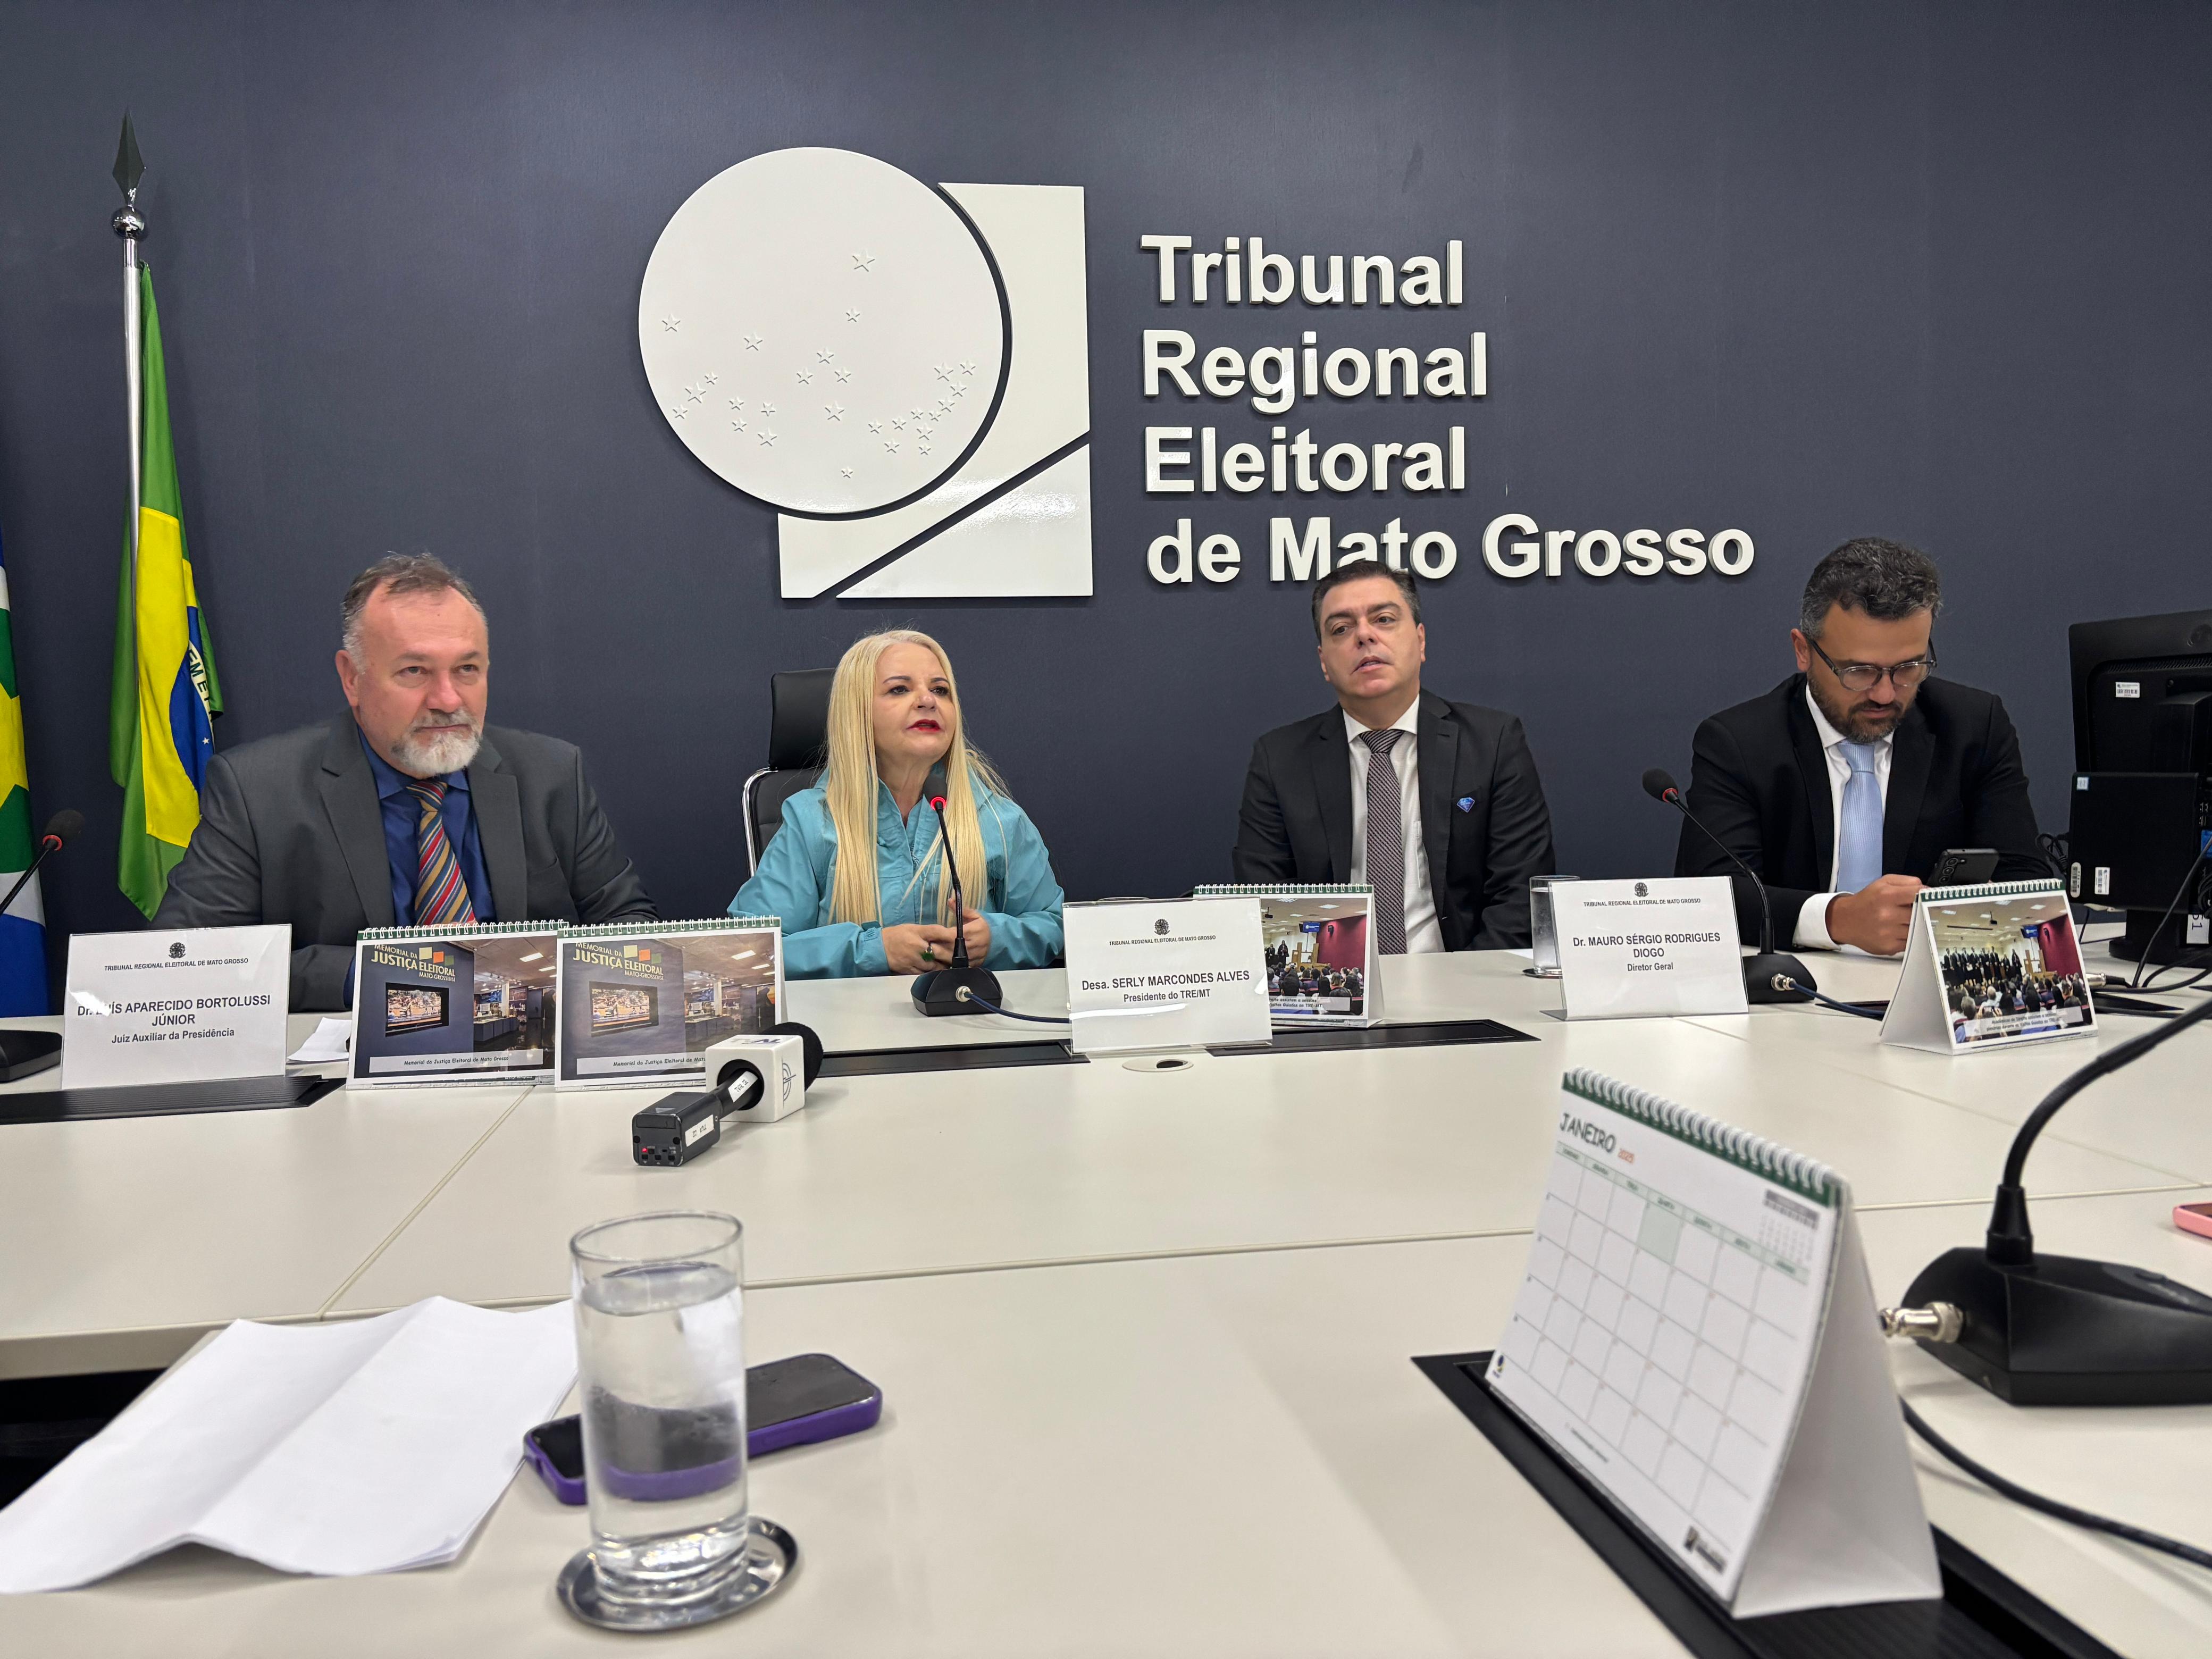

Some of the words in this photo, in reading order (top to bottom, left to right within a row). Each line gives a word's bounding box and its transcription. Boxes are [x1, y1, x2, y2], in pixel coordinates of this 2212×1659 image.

[1141, 234, 1463, 306] Tribunal
[1142, 329, 1487, 415] Regional
[1144, 426, 1465, 493] Eleitoral
[1146, 518, 1242, 584] de
[1270, 517, 1458, 582] Mato
[1482, 513, 1755, 579] Grosso
[575, 942, 613, 955] MEMORIAL
[1573, 937, 1586, 946] Dr.
[1588, 936, 1623, 946] MAURO
[1626, 933, 1662, 945] SÉRGIO
[1665, 932, 1721, 943] RODRIGUES
[374, 944, 409, 957] MEMORIAL
[1633, 948, 1664, 958] DIOGO
[371, 951, 417, 970] JUSTIÇA
[419, 961, 455, 977] ELEITORAL
[573, 949, 623, 969] JUSTIÇA
[624, 959, 664, 975] ELEITORAL
[1627, 963, 1652, 971] Diretor
[1082, 980, 1109, 990] Desa.
[1112, 977, 1145, 988] SERLY
[1148, 973, 1214, 986] MARCONDES
[1217, 970, 1250, 982] ALVES
[1124, 991, 1166, 1002] Presidente
[1168, 991, 1178, 1000] do
[1180, 988, 1211, 999] TRE/MT
[78, 1006, 92, 1016] Dr.
[125, 1000, 193, 1013] APARECIDO
[197, 995, 270, 1009] BORTOLUSSI
[152, 1013, 195, 1026] JÚNIOR
[112, 1034, 130, 1043] Juiz
[132, 1033, 166, 1042] Auxiliar
[182, 1028, 234, 1039] Presidência
[1560, 1112, 1616, 1153] JANEIRO
